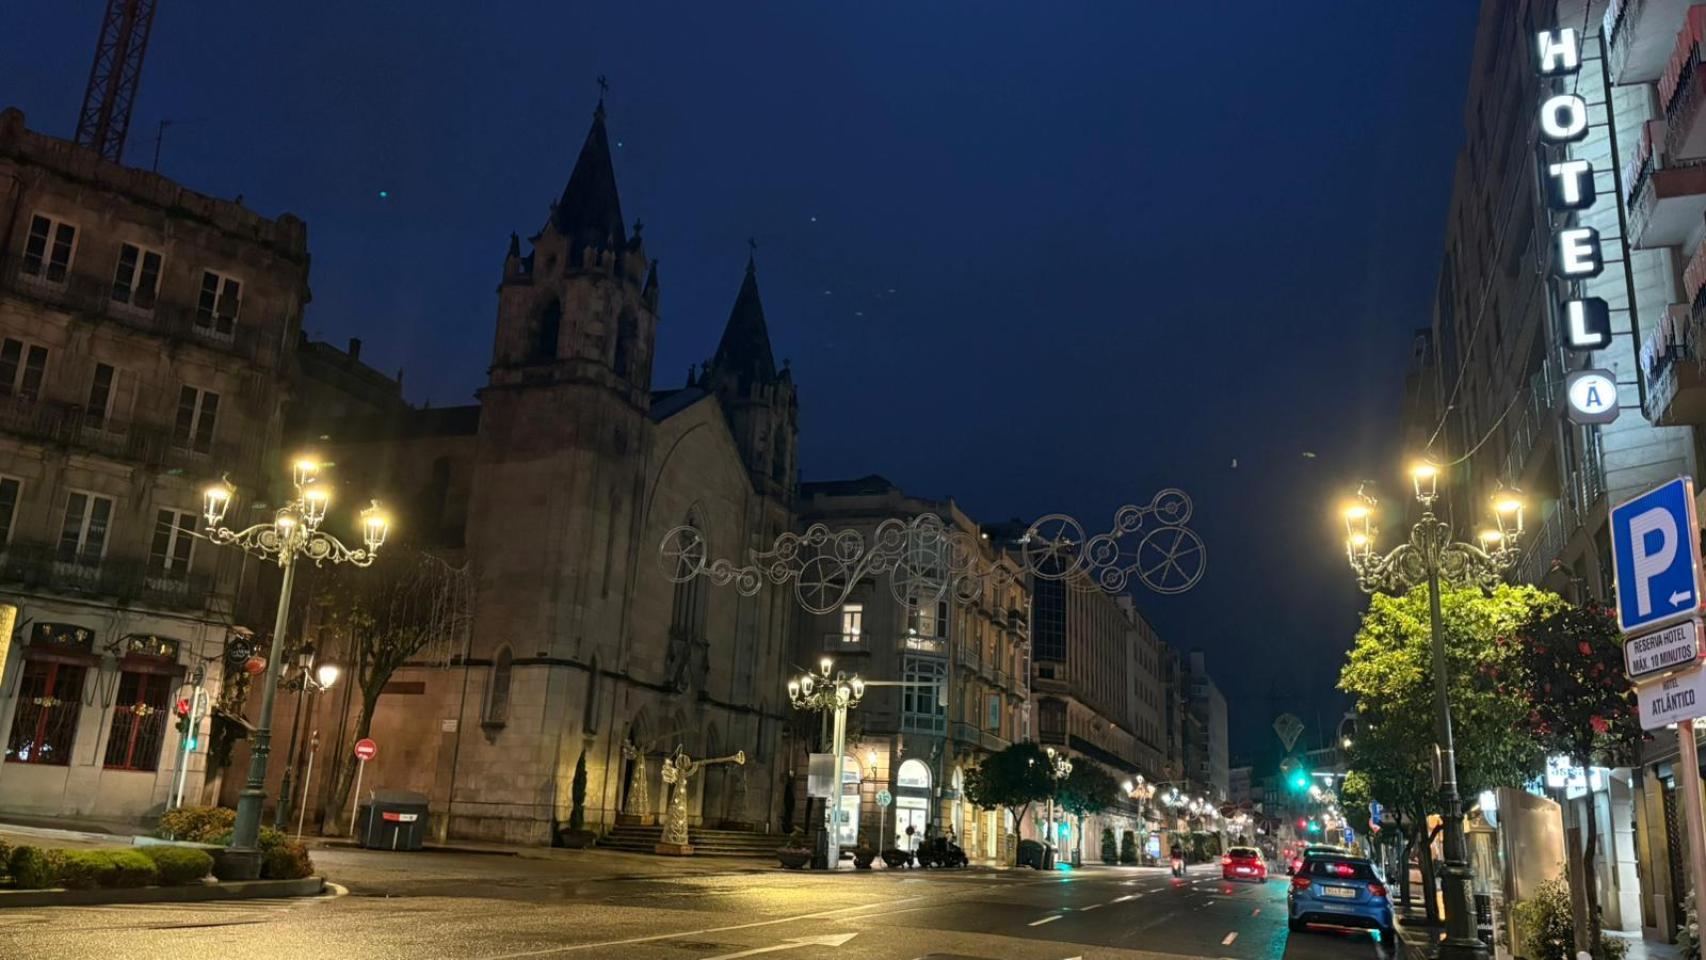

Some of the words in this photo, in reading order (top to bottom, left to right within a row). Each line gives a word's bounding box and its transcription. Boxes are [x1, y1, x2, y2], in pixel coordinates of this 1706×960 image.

[1538, 30, 1602, 346] HOTEL
[1629, 507, 1678, 617] P
[1634, 634, 1663, 654] RESERVA
[1663, 627, 1687, 645] HOTEL
[1651, 654, 1659, 668] 10
[1660, 644, 1692, 664] MINUTOS
[1663, 677, 1679, 690] HOTEL
[1652, 688, 1695, 716] ATLÁNTICO
